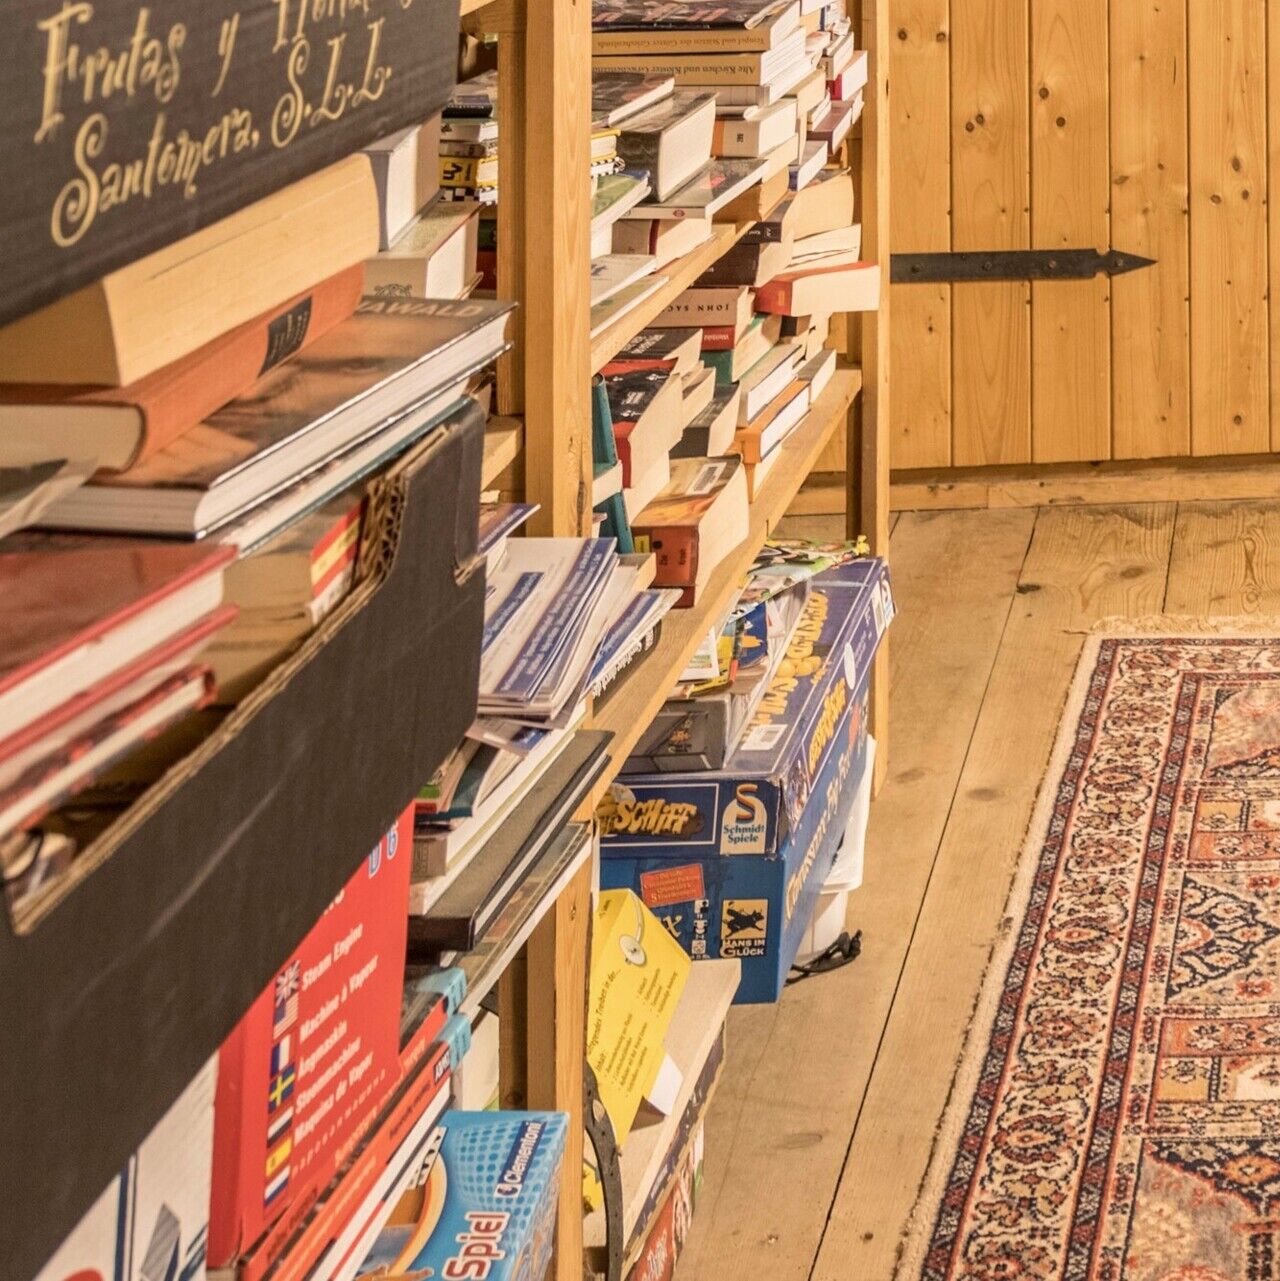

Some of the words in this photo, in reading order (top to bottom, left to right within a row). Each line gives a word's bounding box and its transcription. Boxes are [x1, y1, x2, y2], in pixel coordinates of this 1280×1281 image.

[35, 0, 188, 143] Frutas
[212, 12, 240, 97] y
[682, 64, 702, 75] und
[662, 303, 690, 313] SAC
[697, 303, 730, 313] JOHN
[723, 823, 766, 834] Schmidt
[728, 833, 759, 844] Spiele
[302, 953, 333, 992] Steam
[333, 923, 363, 962] Engine
[504, 1120, 542, 1184] Clementoni
[445, 1213, 507, 1278] Spiel
